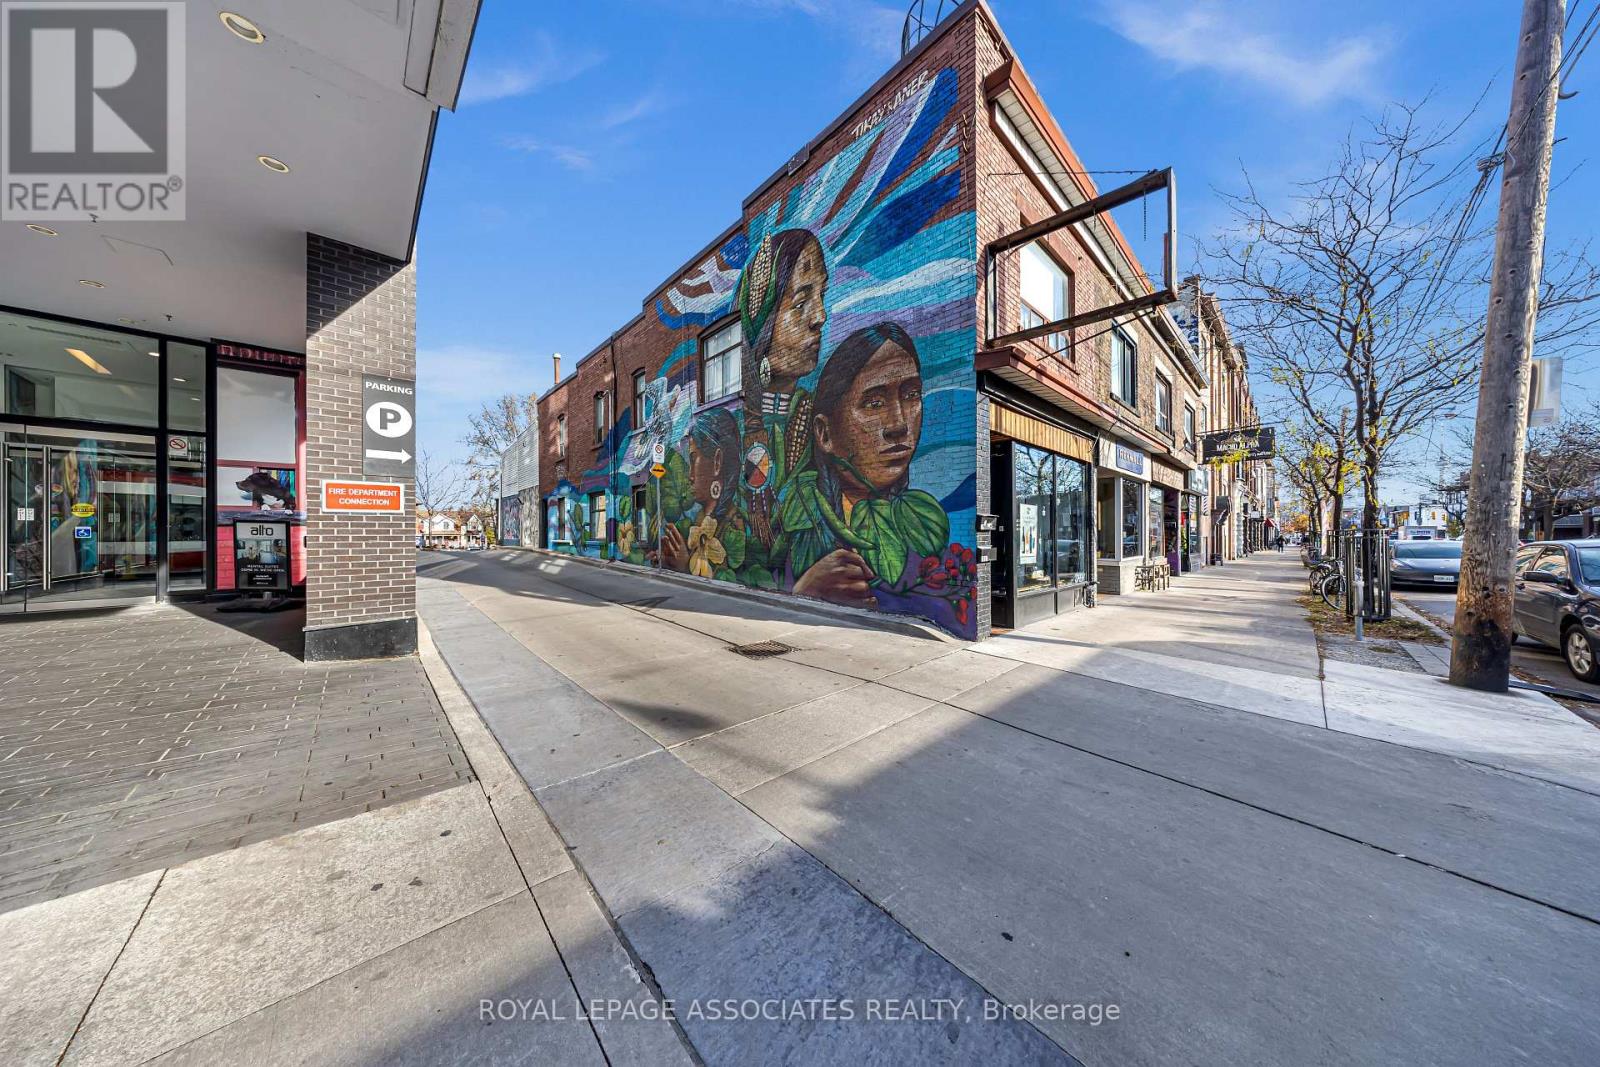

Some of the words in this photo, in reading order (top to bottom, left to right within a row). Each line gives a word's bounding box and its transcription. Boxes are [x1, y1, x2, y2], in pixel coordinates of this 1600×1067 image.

[365, 381, 413, 395] PARKING
[379, 407, 402, 430] P
[328, 487, 347, 495] FIRE
[348, 488, 397, 497] DEPARTMENT
